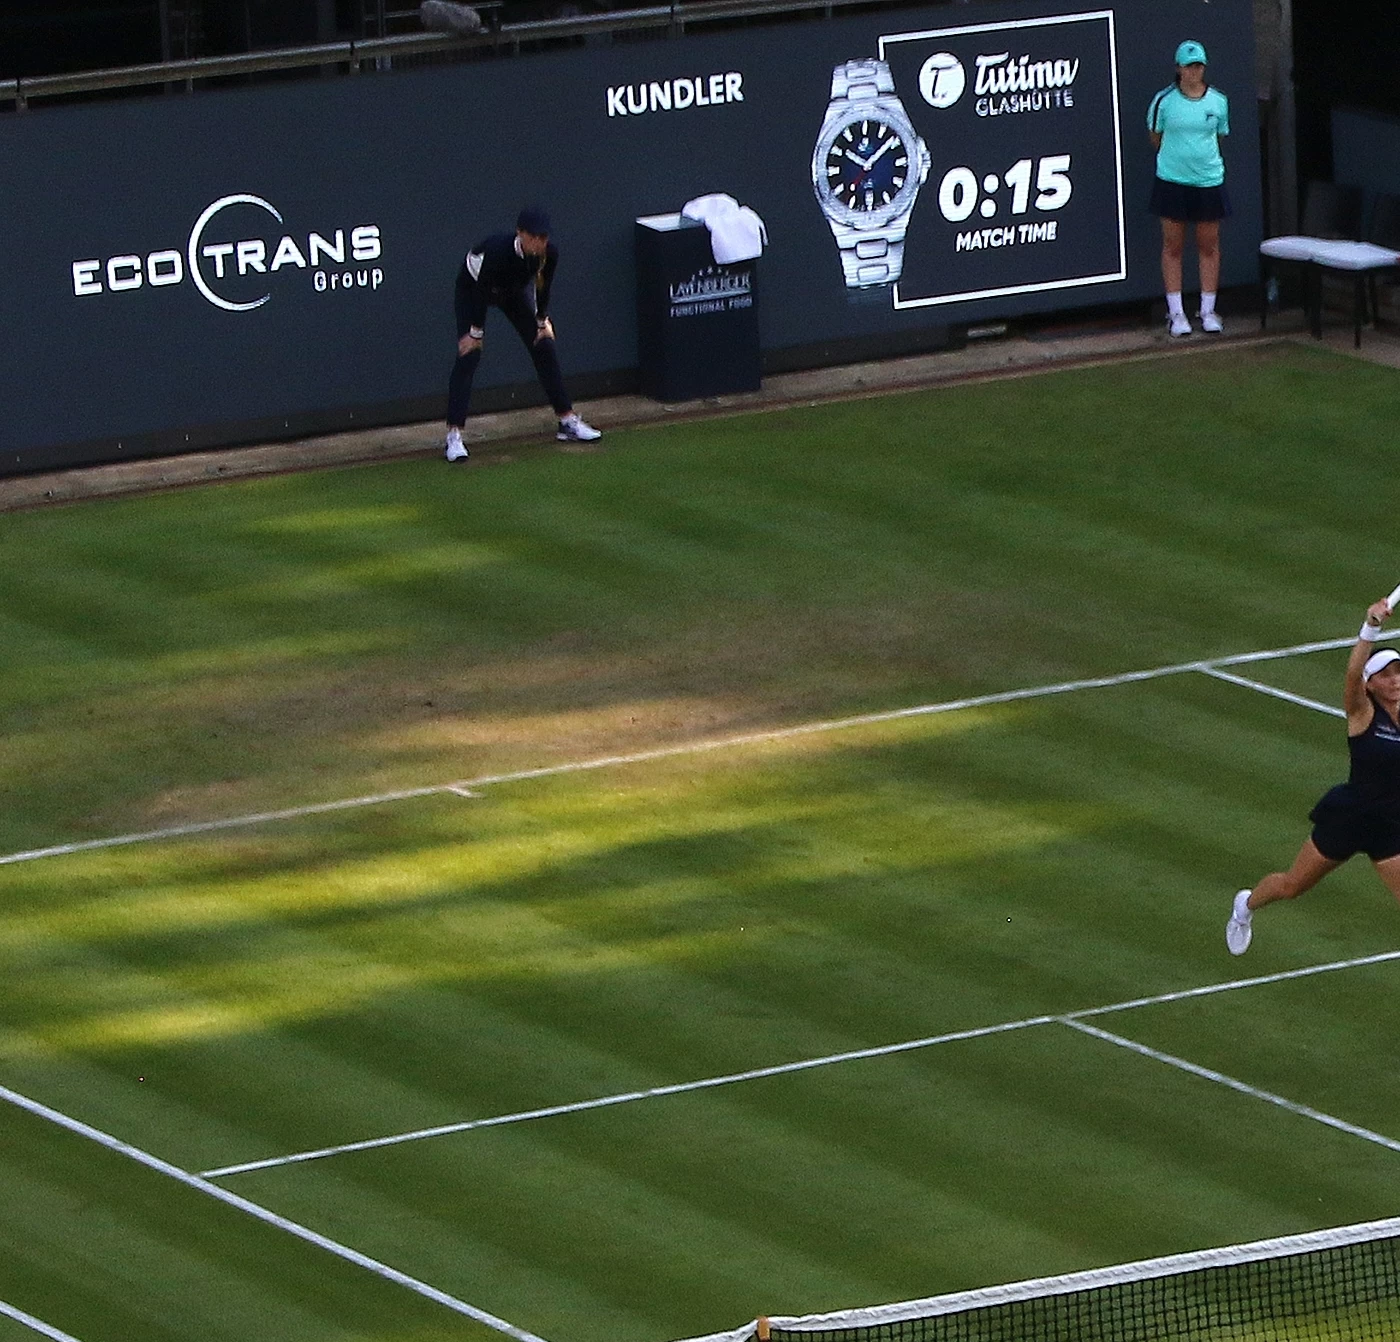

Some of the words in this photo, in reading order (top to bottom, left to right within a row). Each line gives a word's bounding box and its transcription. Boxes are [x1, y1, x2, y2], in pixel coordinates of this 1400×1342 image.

[974, 52, 1079, 95] Tutima
[606, 72, 743, 117] KUNDLER
[975, 90, 1075, 117] GLASHÜTTE
[938, 154, 1073, 222] 0:15
[956, 225, 1015, 252] MATCH
[1018, 221, 1058, 244] TIME
[313, 266, 384, 293] Group
